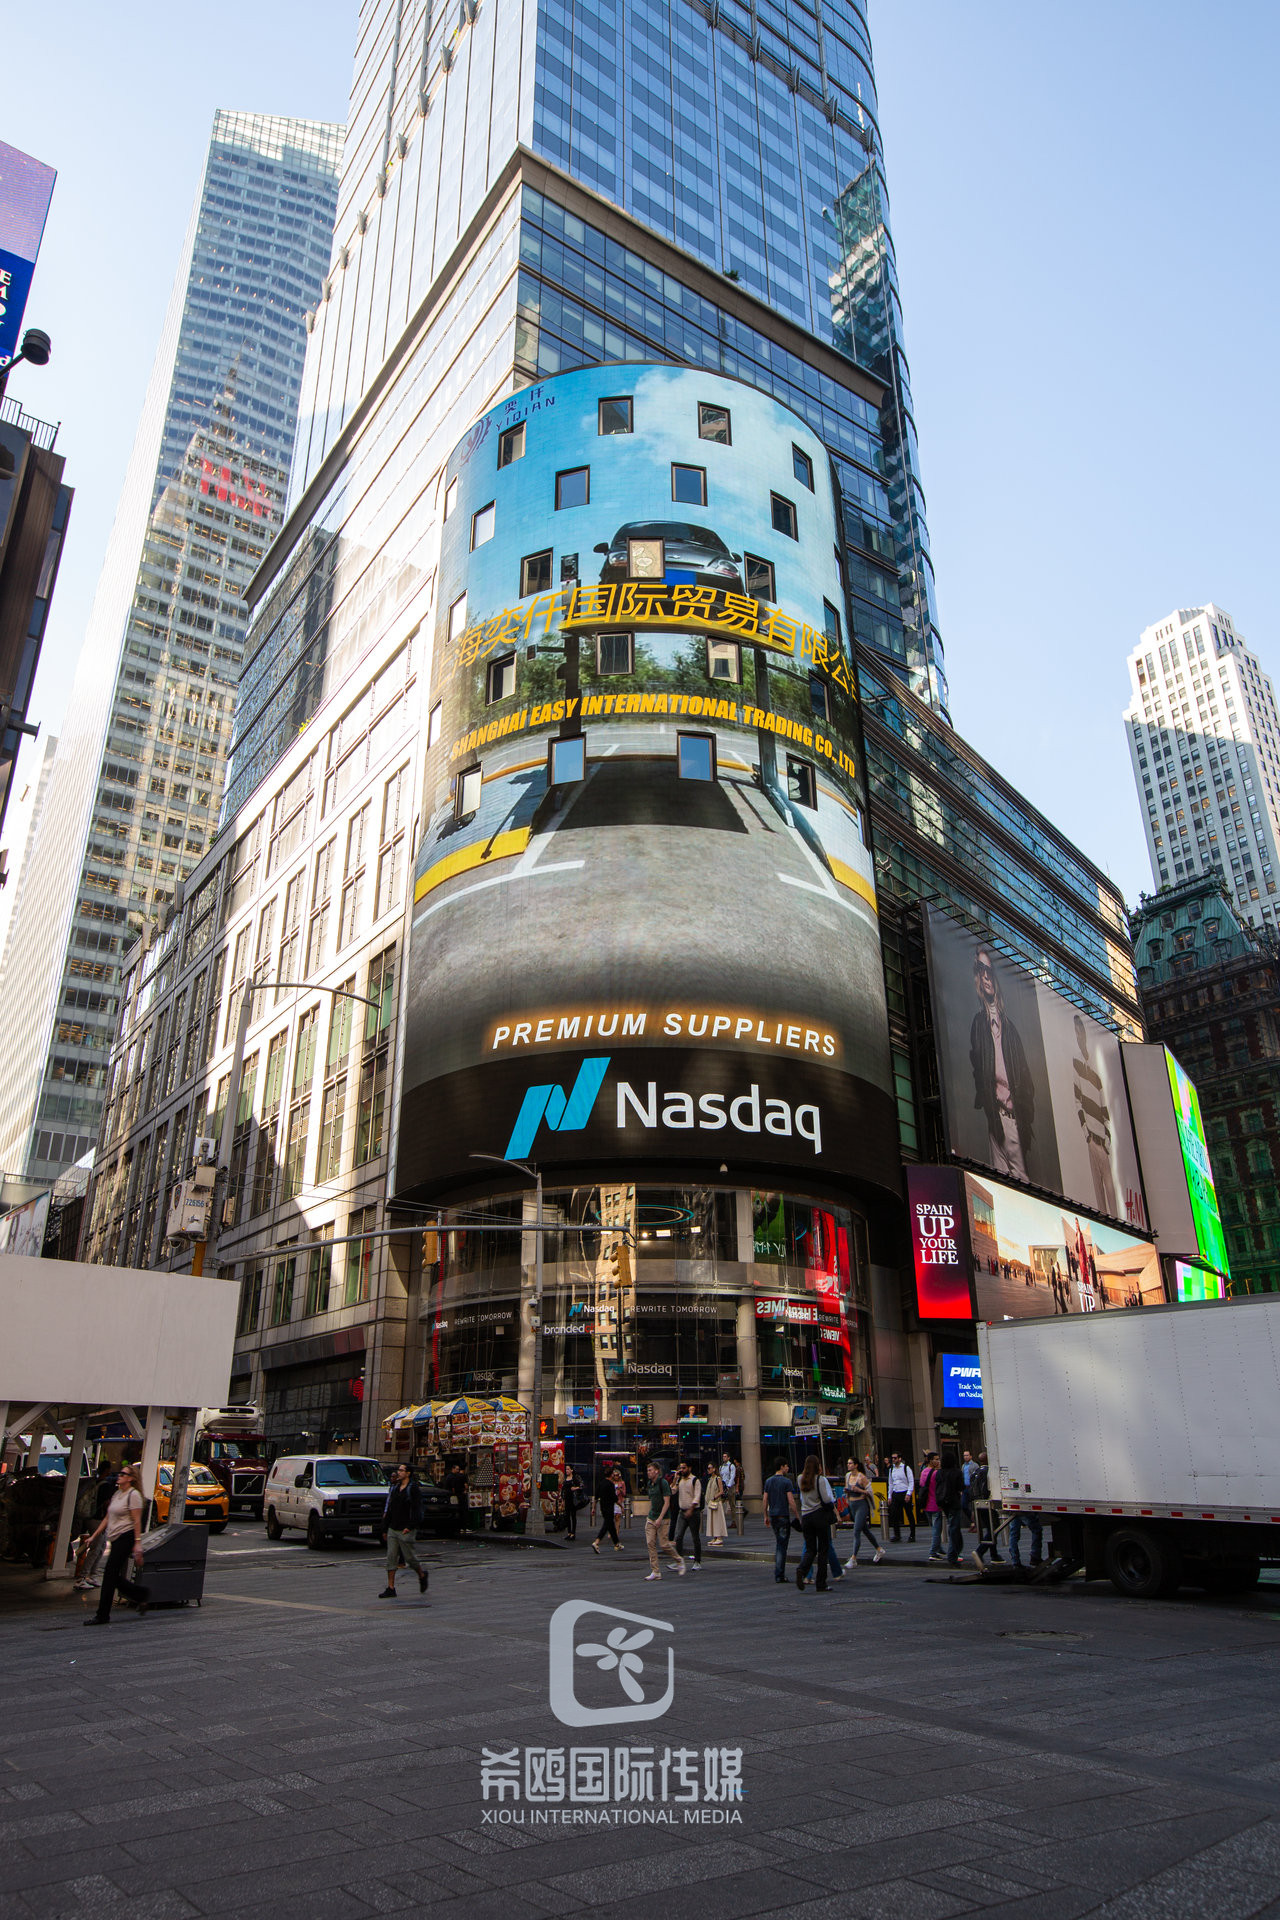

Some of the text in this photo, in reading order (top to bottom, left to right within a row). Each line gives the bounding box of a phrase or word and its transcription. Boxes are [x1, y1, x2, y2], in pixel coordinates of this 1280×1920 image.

[496, 396, 555, 431] YIQIAN
[451, 693, 856, 779] SHANGHAI EASY INTERNATIONAL TRADING CO., LTD
[492, 1013, 836, 1056] PREMIUM SUPPLIERS
[616, 1081, 822, 1154] Nasdaq
[916, 1203, 953, 1216] SPAIN
[917, 1215, 955, 1238] UP
[919, 1237, 957, 1250] YOUR
[920, 1249, 959, 1265] LIFE
[583, 1304, 615, 1314] Nasdaq
[630, 1305, 718, 1314] REWRITE TOMORROW
[1079, 1292, 1096, 1313] UP
[477, 1311, 513, 1322] TOMORROW
[627, 1362, 673, 1376] Nasdaq
[782, 1367, 804, 1378] Nasdaq
